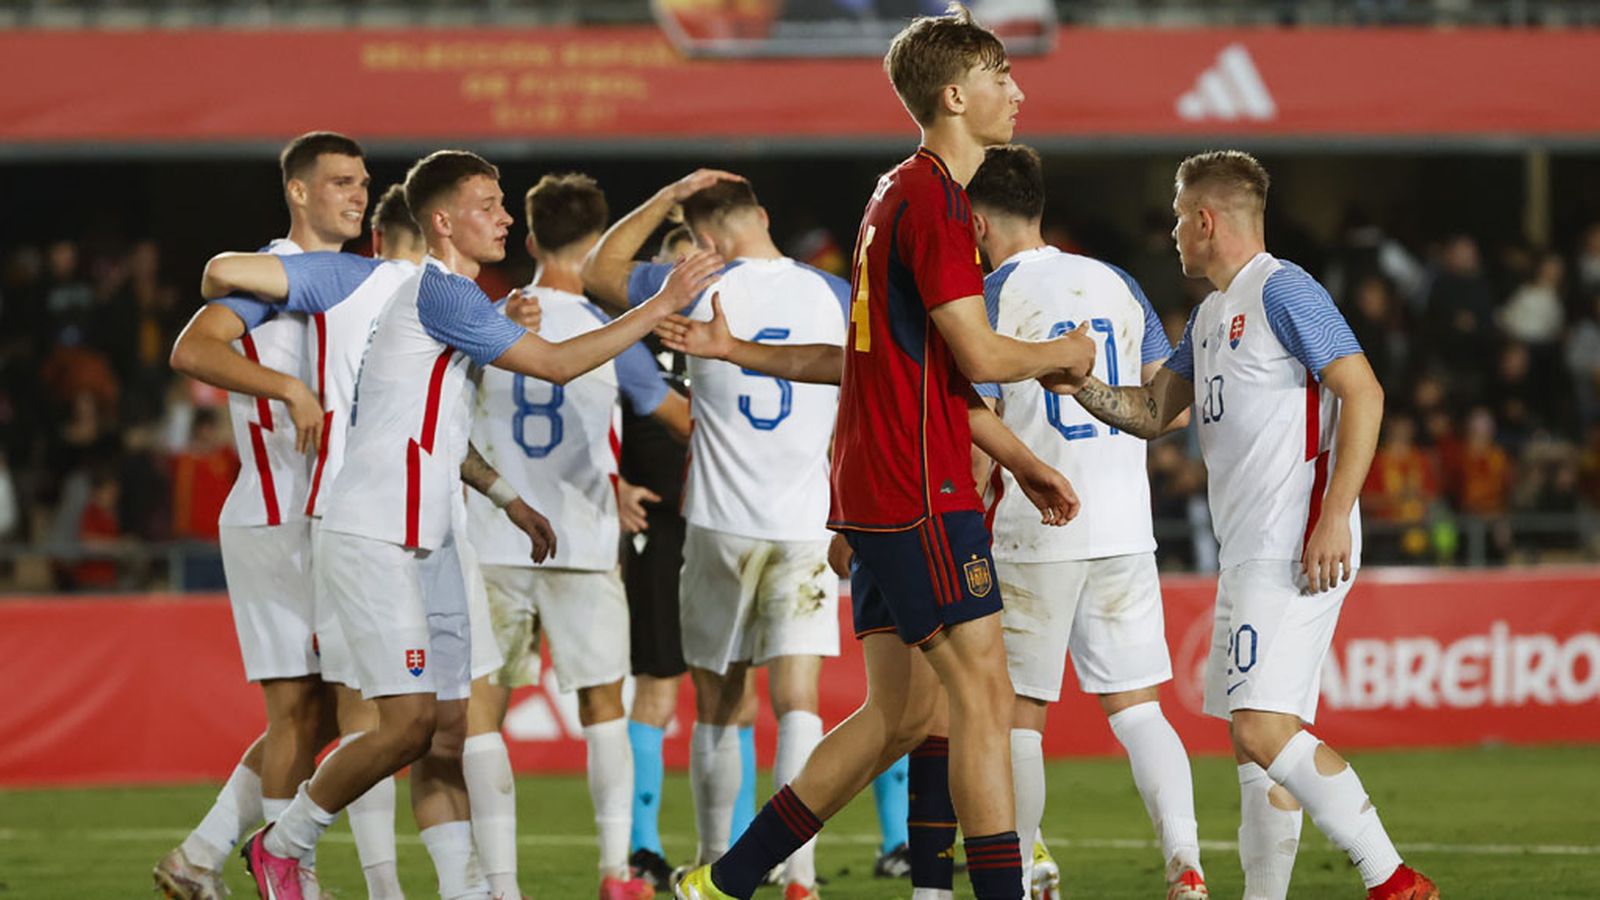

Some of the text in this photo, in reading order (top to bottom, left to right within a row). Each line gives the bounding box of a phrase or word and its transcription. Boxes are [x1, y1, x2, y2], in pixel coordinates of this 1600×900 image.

[512, 371, 565, 459] 8
[738, 327, 793, 431] 5
[1045, 317, 1120, 441] 21
